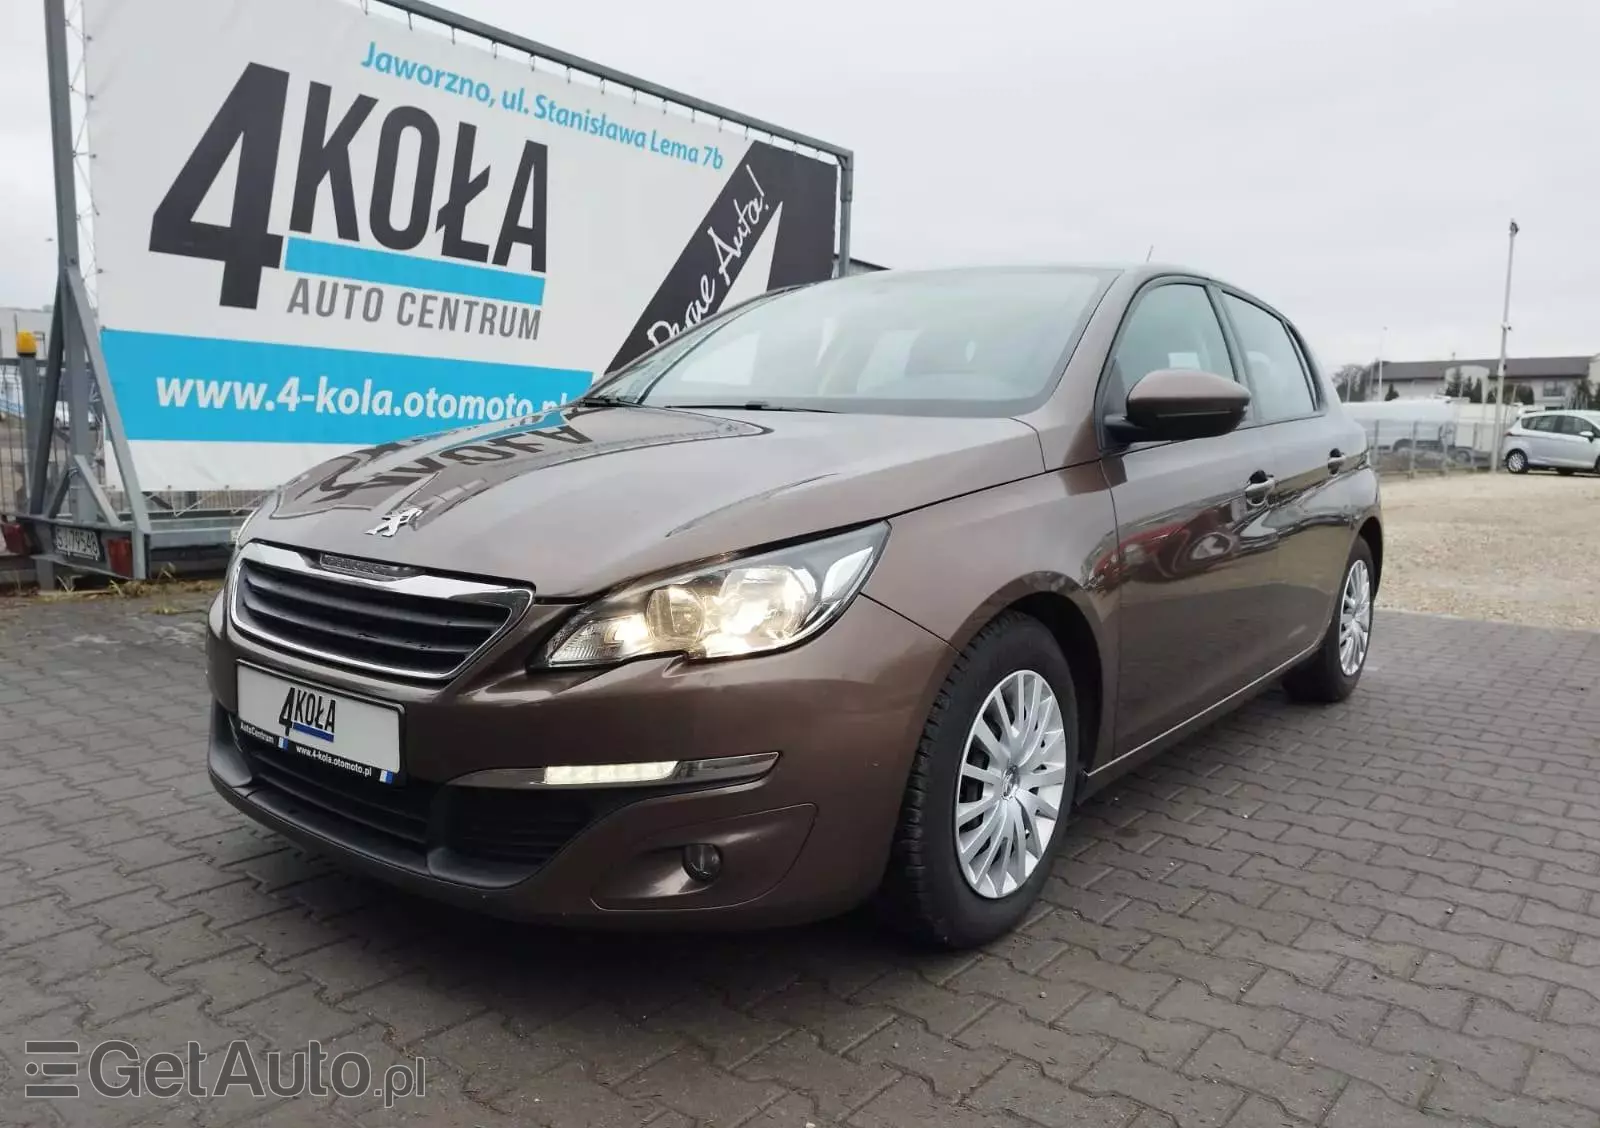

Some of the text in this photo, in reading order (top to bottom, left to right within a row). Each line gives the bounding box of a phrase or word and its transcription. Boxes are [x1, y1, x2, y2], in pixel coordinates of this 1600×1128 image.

[360, 41, 724, 171] Jaworzno, ul. Stanisława Lema 7b
[707, 163, 770, 286] Auta!
[286, 277, 542, 341] AUTO CENTRUM
[156, 375, 568, 421] www.4-kola.otomoto
[296, 744, 373, 778] www.4-kola.otomoto.pl
